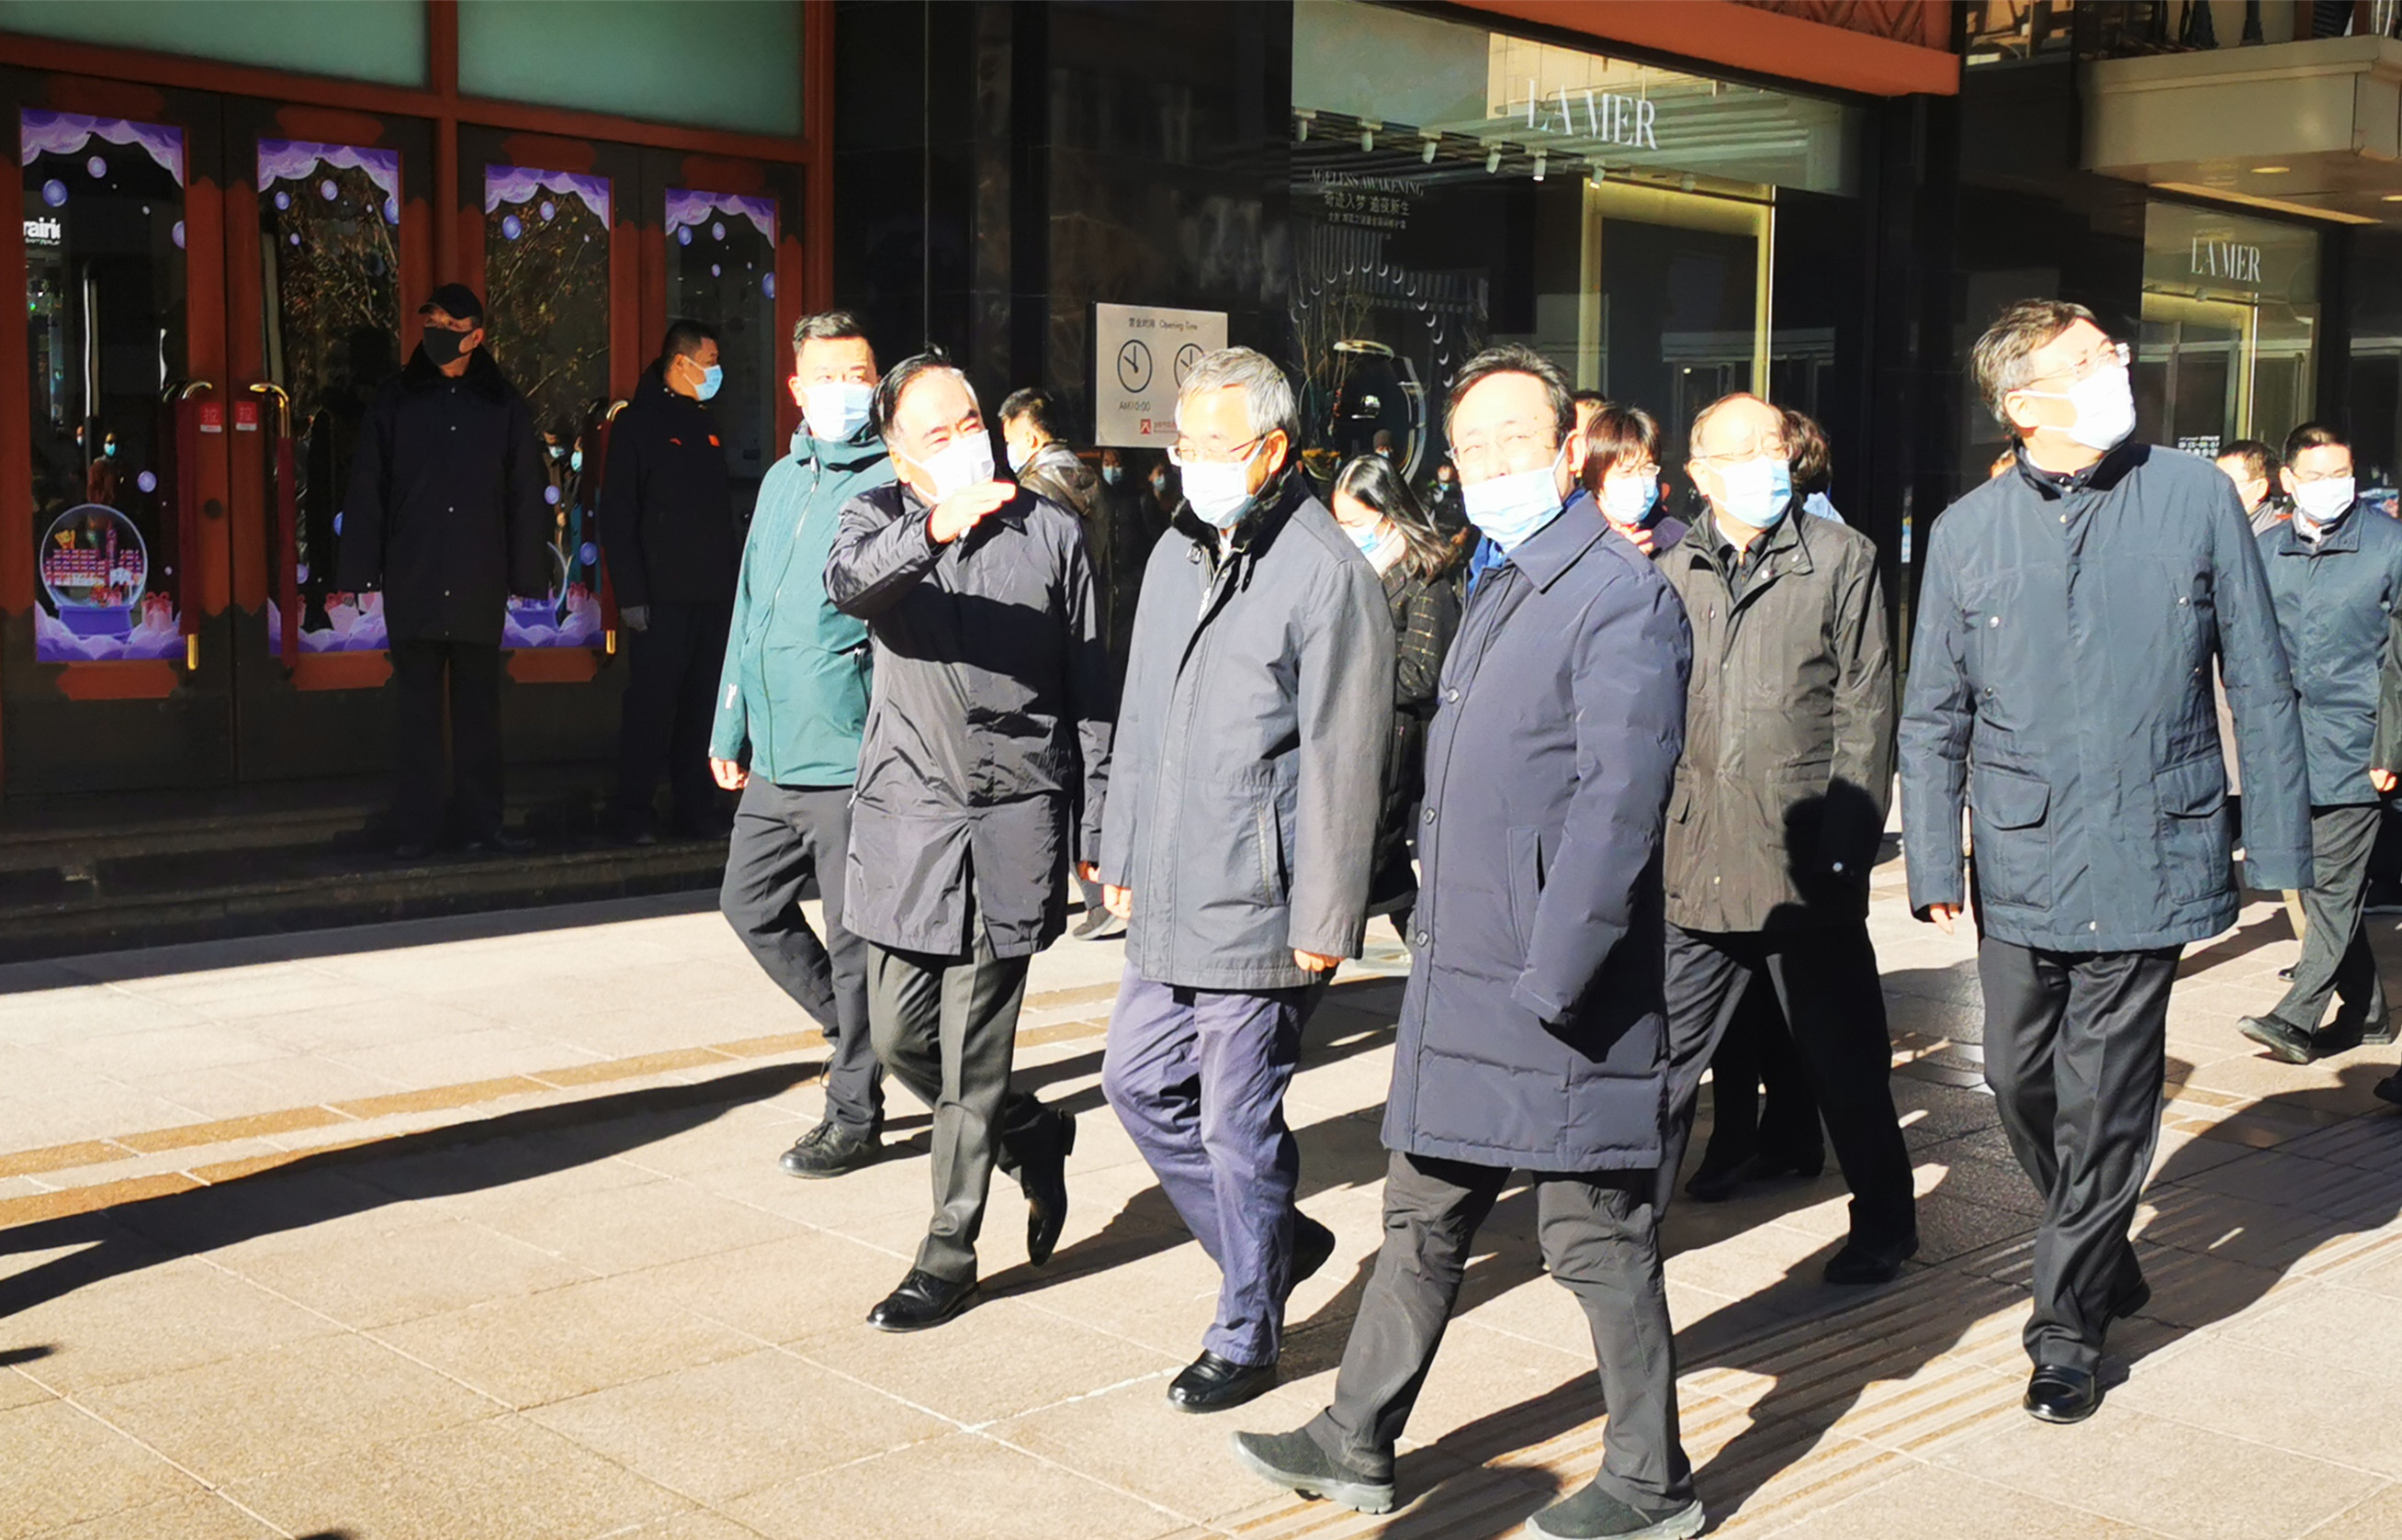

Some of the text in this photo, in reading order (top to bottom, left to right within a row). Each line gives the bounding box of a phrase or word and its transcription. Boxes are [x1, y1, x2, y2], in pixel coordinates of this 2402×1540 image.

[1526, 79, 1658, 151] LA MER
[1310, 168, 1424, 197] AGELESS AWAKENING
[2192, 237, 2261, 284] LA MER
